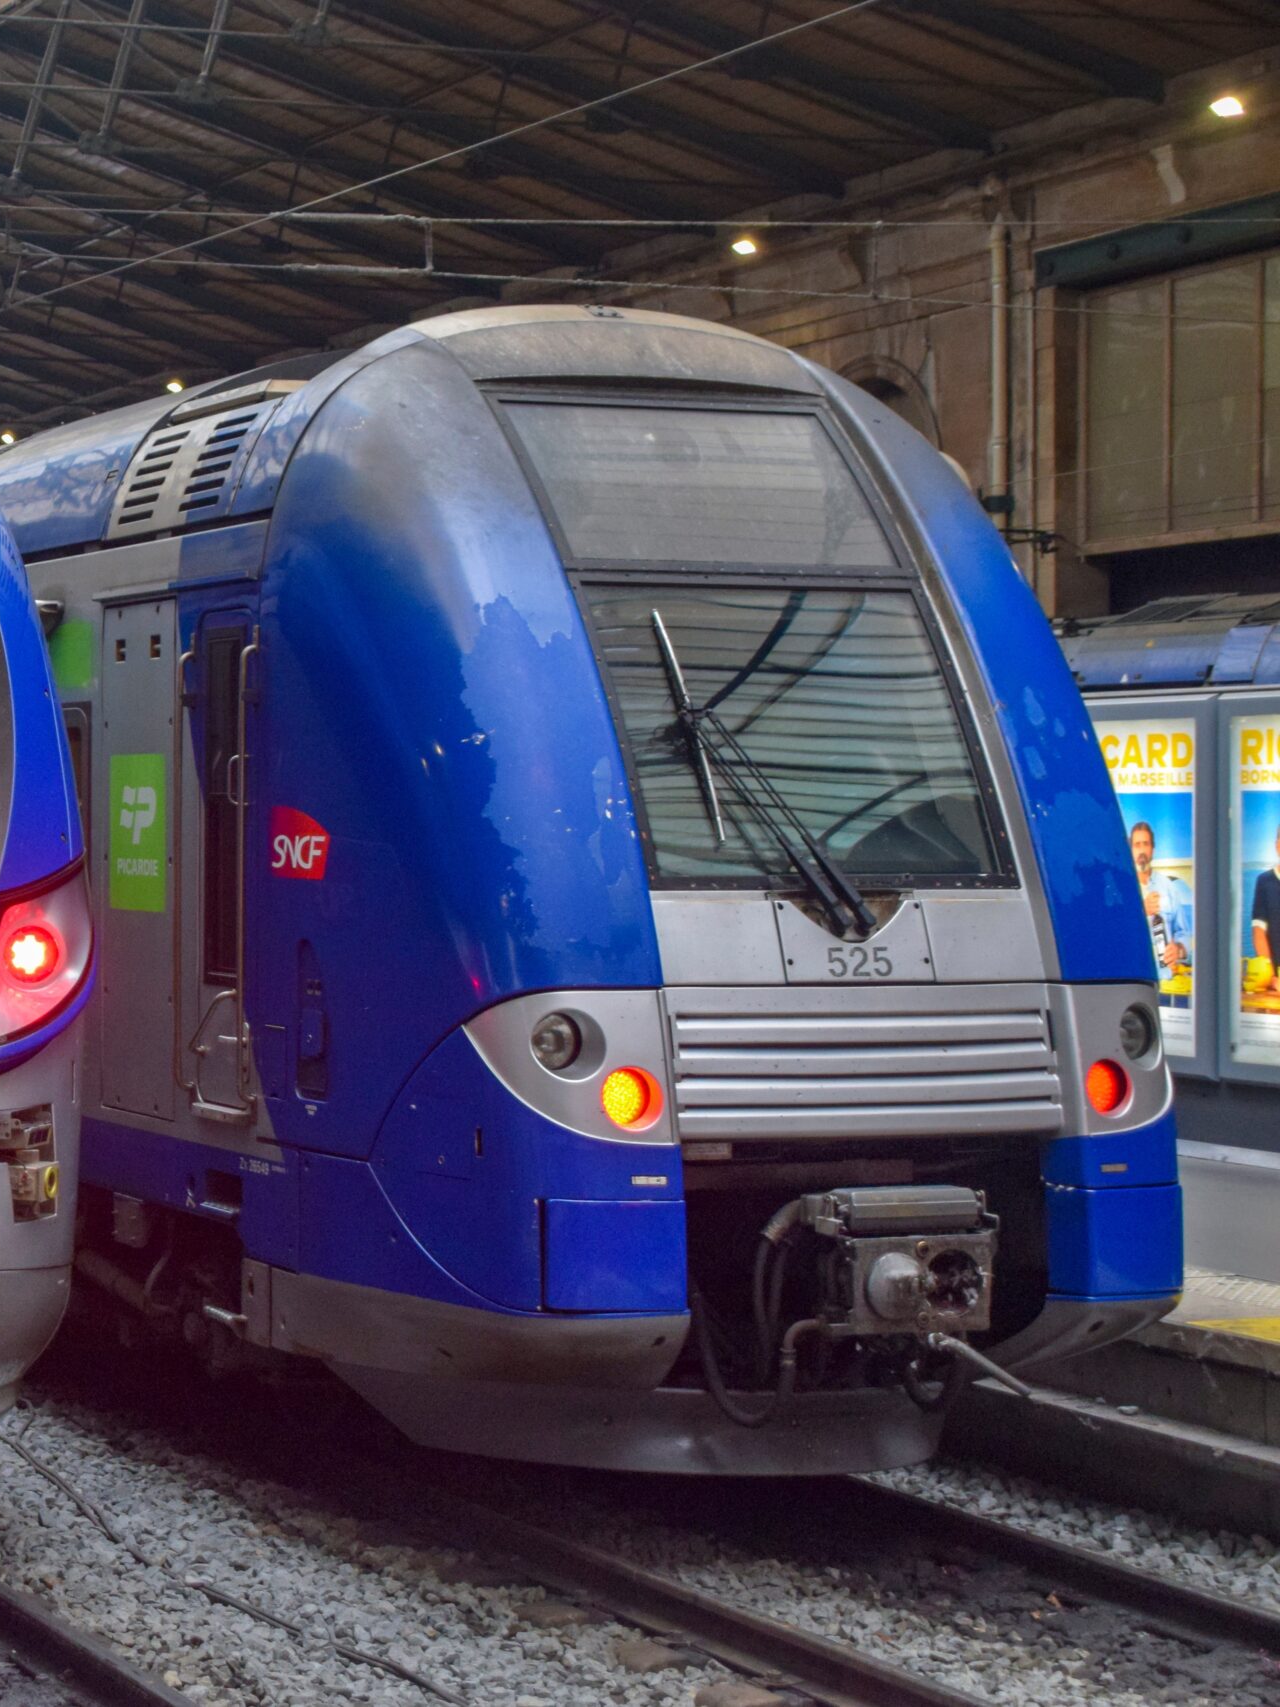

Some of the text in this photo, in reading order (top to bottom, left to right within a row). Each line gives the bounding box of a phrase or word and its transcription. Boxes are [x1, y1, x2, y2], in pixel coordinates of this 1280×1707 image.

[1240, 729, 1280, 766] RI
[1118, 772, 1193, 786] MARSEILLE
[117, 857, 159, 876] PICARDIE
[271, 834, 326, 869] SNCF
[827, 946, 893, 977] 525
